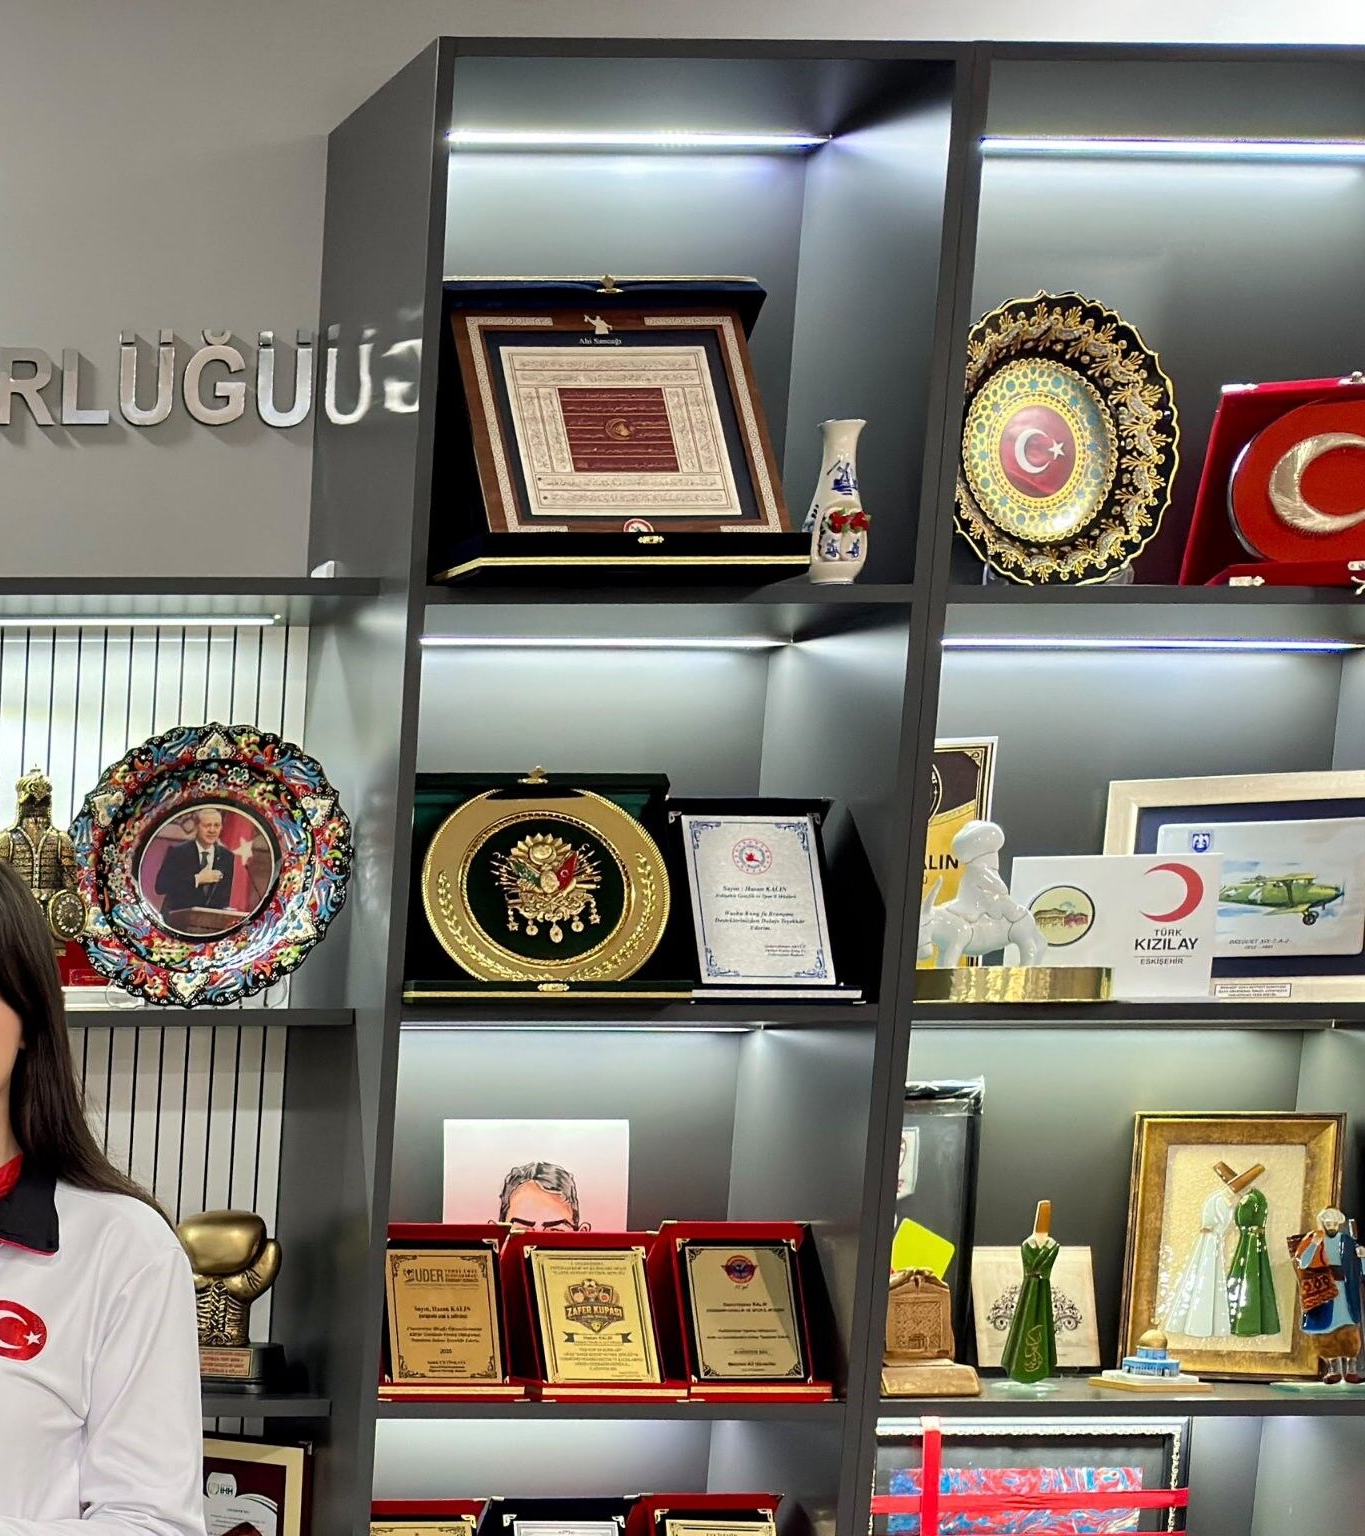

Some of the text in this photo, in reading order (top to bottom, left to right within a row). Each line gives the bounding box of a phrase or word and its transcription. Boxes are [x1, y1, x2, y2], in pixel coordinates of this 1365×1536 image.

[924, 854, 959, 870] LIN
[1154, 927, 1183, 937] TÜRK
[1134, 937, 1199, 951] KIZILAY
[1140, 957, 1184, 966] ESKİŞEHİR
[566, 1305, 623, 1318] ZAFER KUPASI
